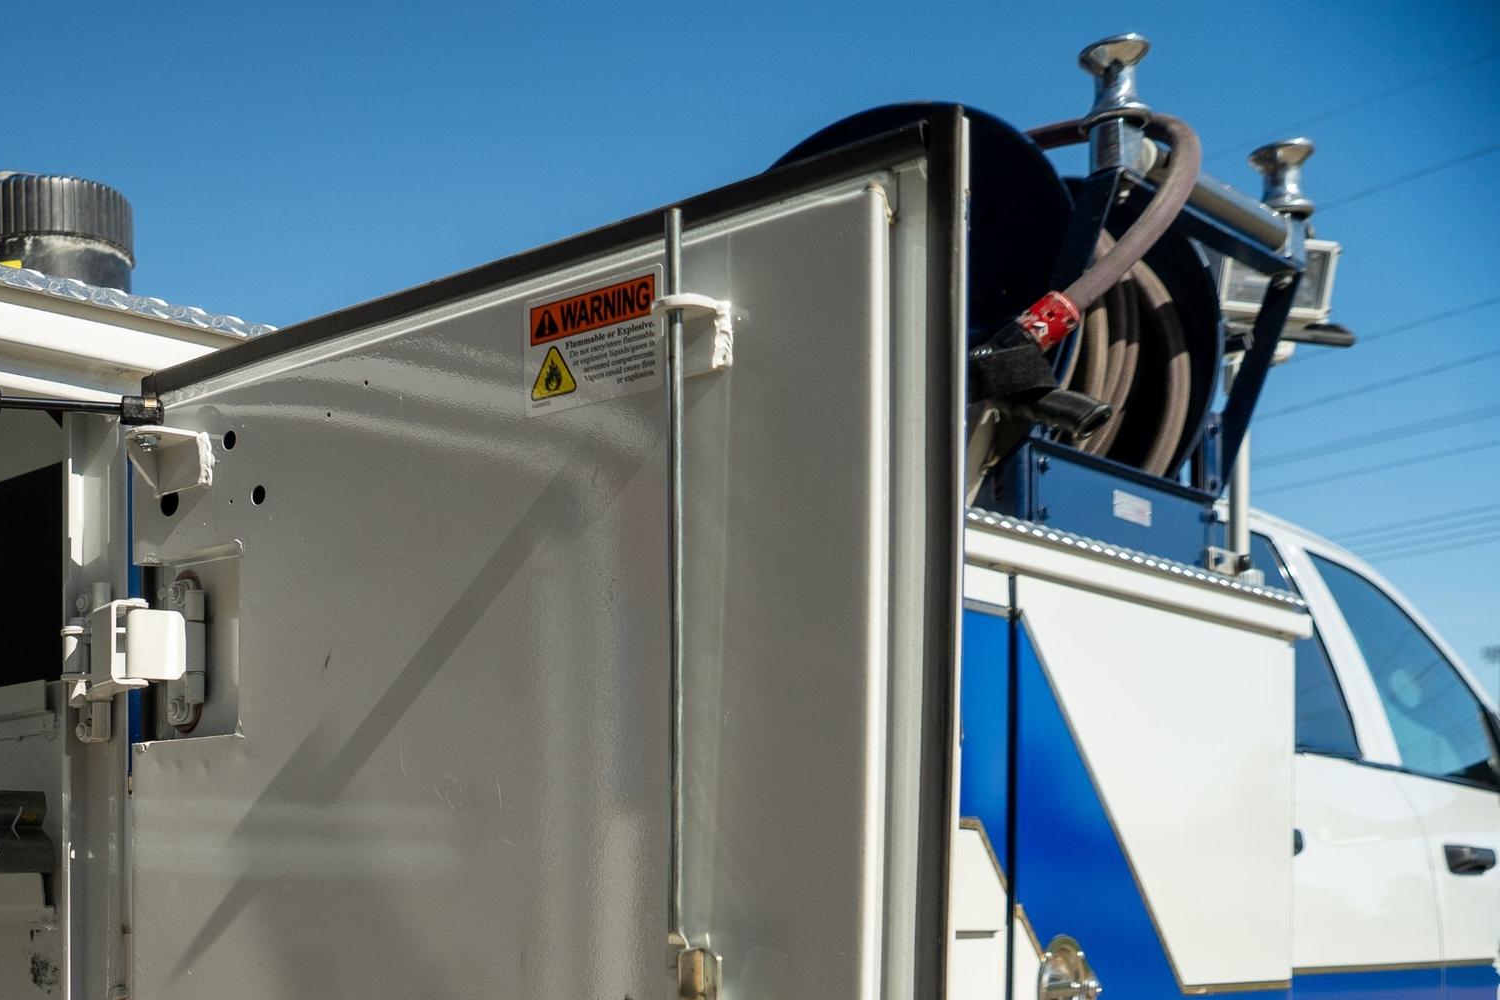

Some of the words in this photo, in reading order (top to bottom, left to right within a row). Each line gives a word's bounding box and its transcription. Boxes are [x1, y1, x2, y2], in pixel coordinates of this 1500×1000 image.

[560, 281, 650, 332] WARNING
[565, 333, 605, 349] Flammable
[569, 351, 578, 359] Do
[623, 330, 655, 344] flammable
[580, 352, 608, 365] explosive
